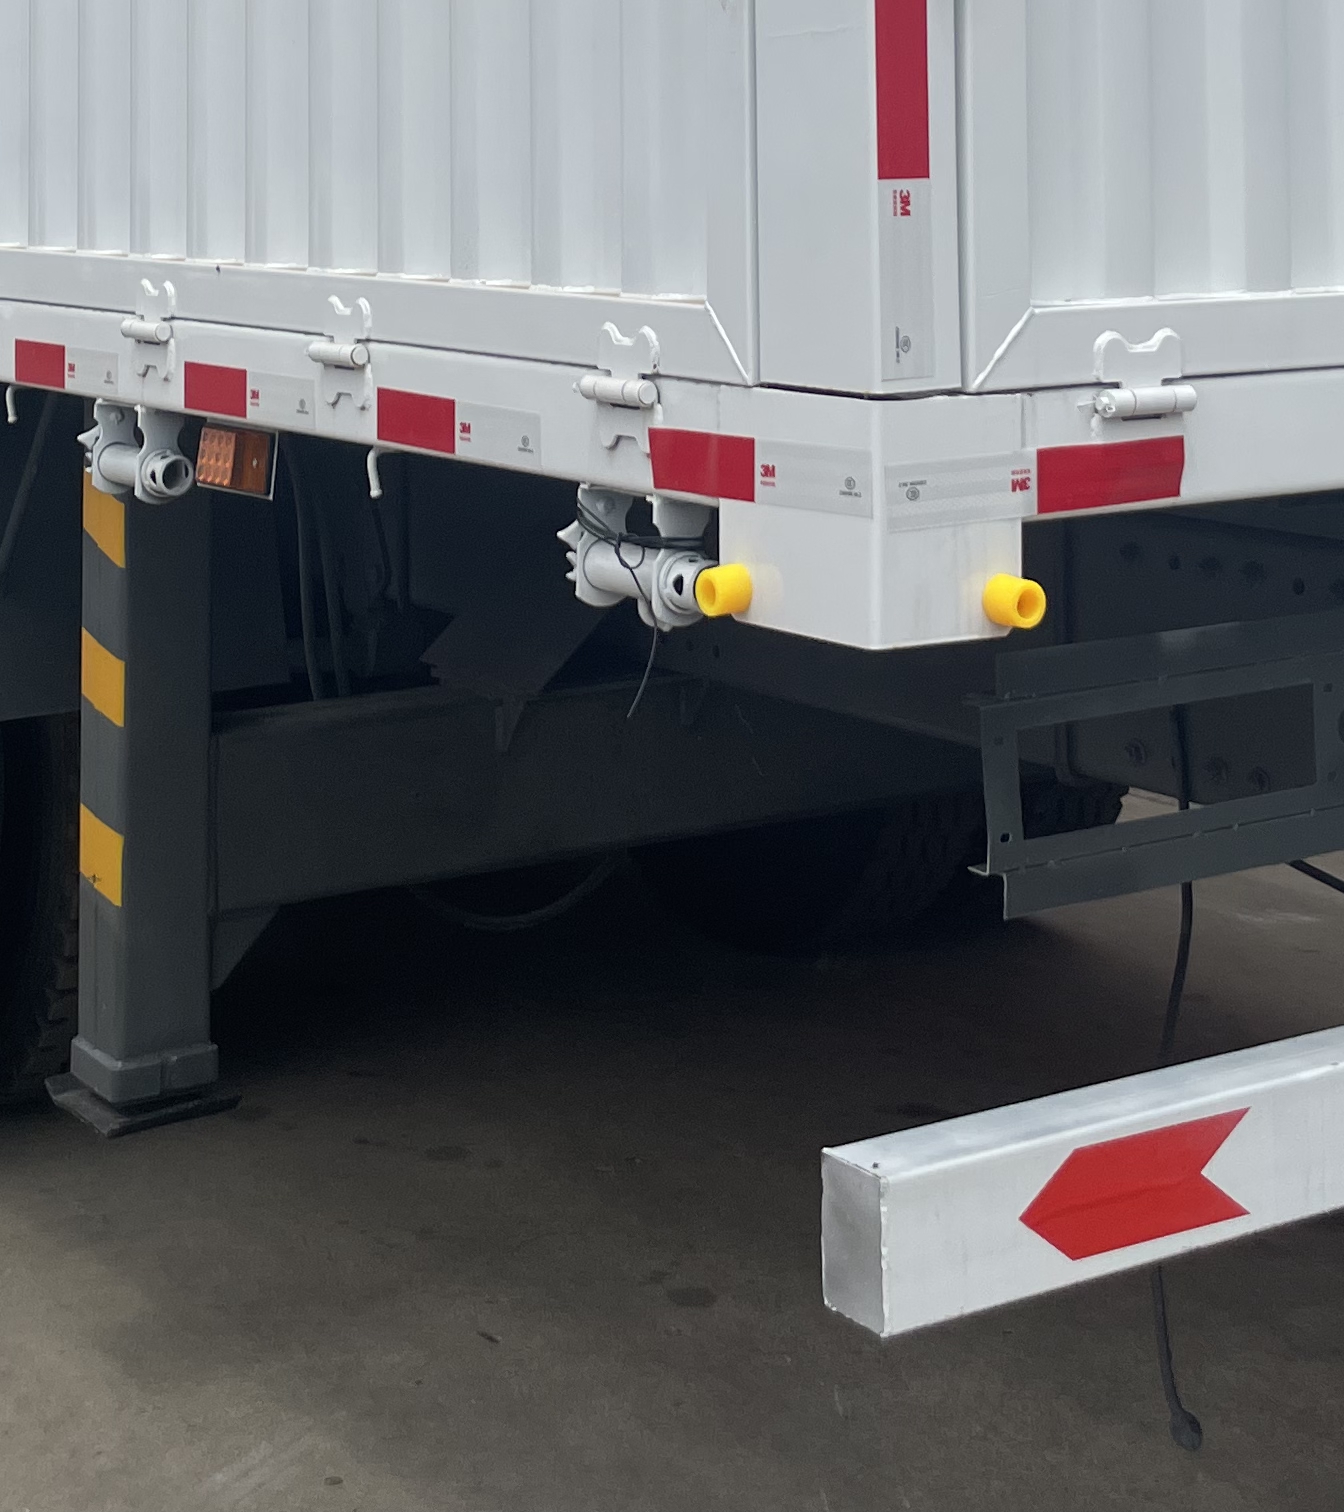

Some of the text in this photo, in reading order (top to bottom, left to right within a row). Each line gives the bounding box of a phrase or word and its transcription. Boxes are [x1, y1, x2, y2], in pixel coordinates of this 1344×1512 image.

[899, 190, 911, 216] 3M
[460, 423, 472, 435] 3M
[761, 464, 777, 479] 3M
[1011, 477, 1030, 492] 3M
